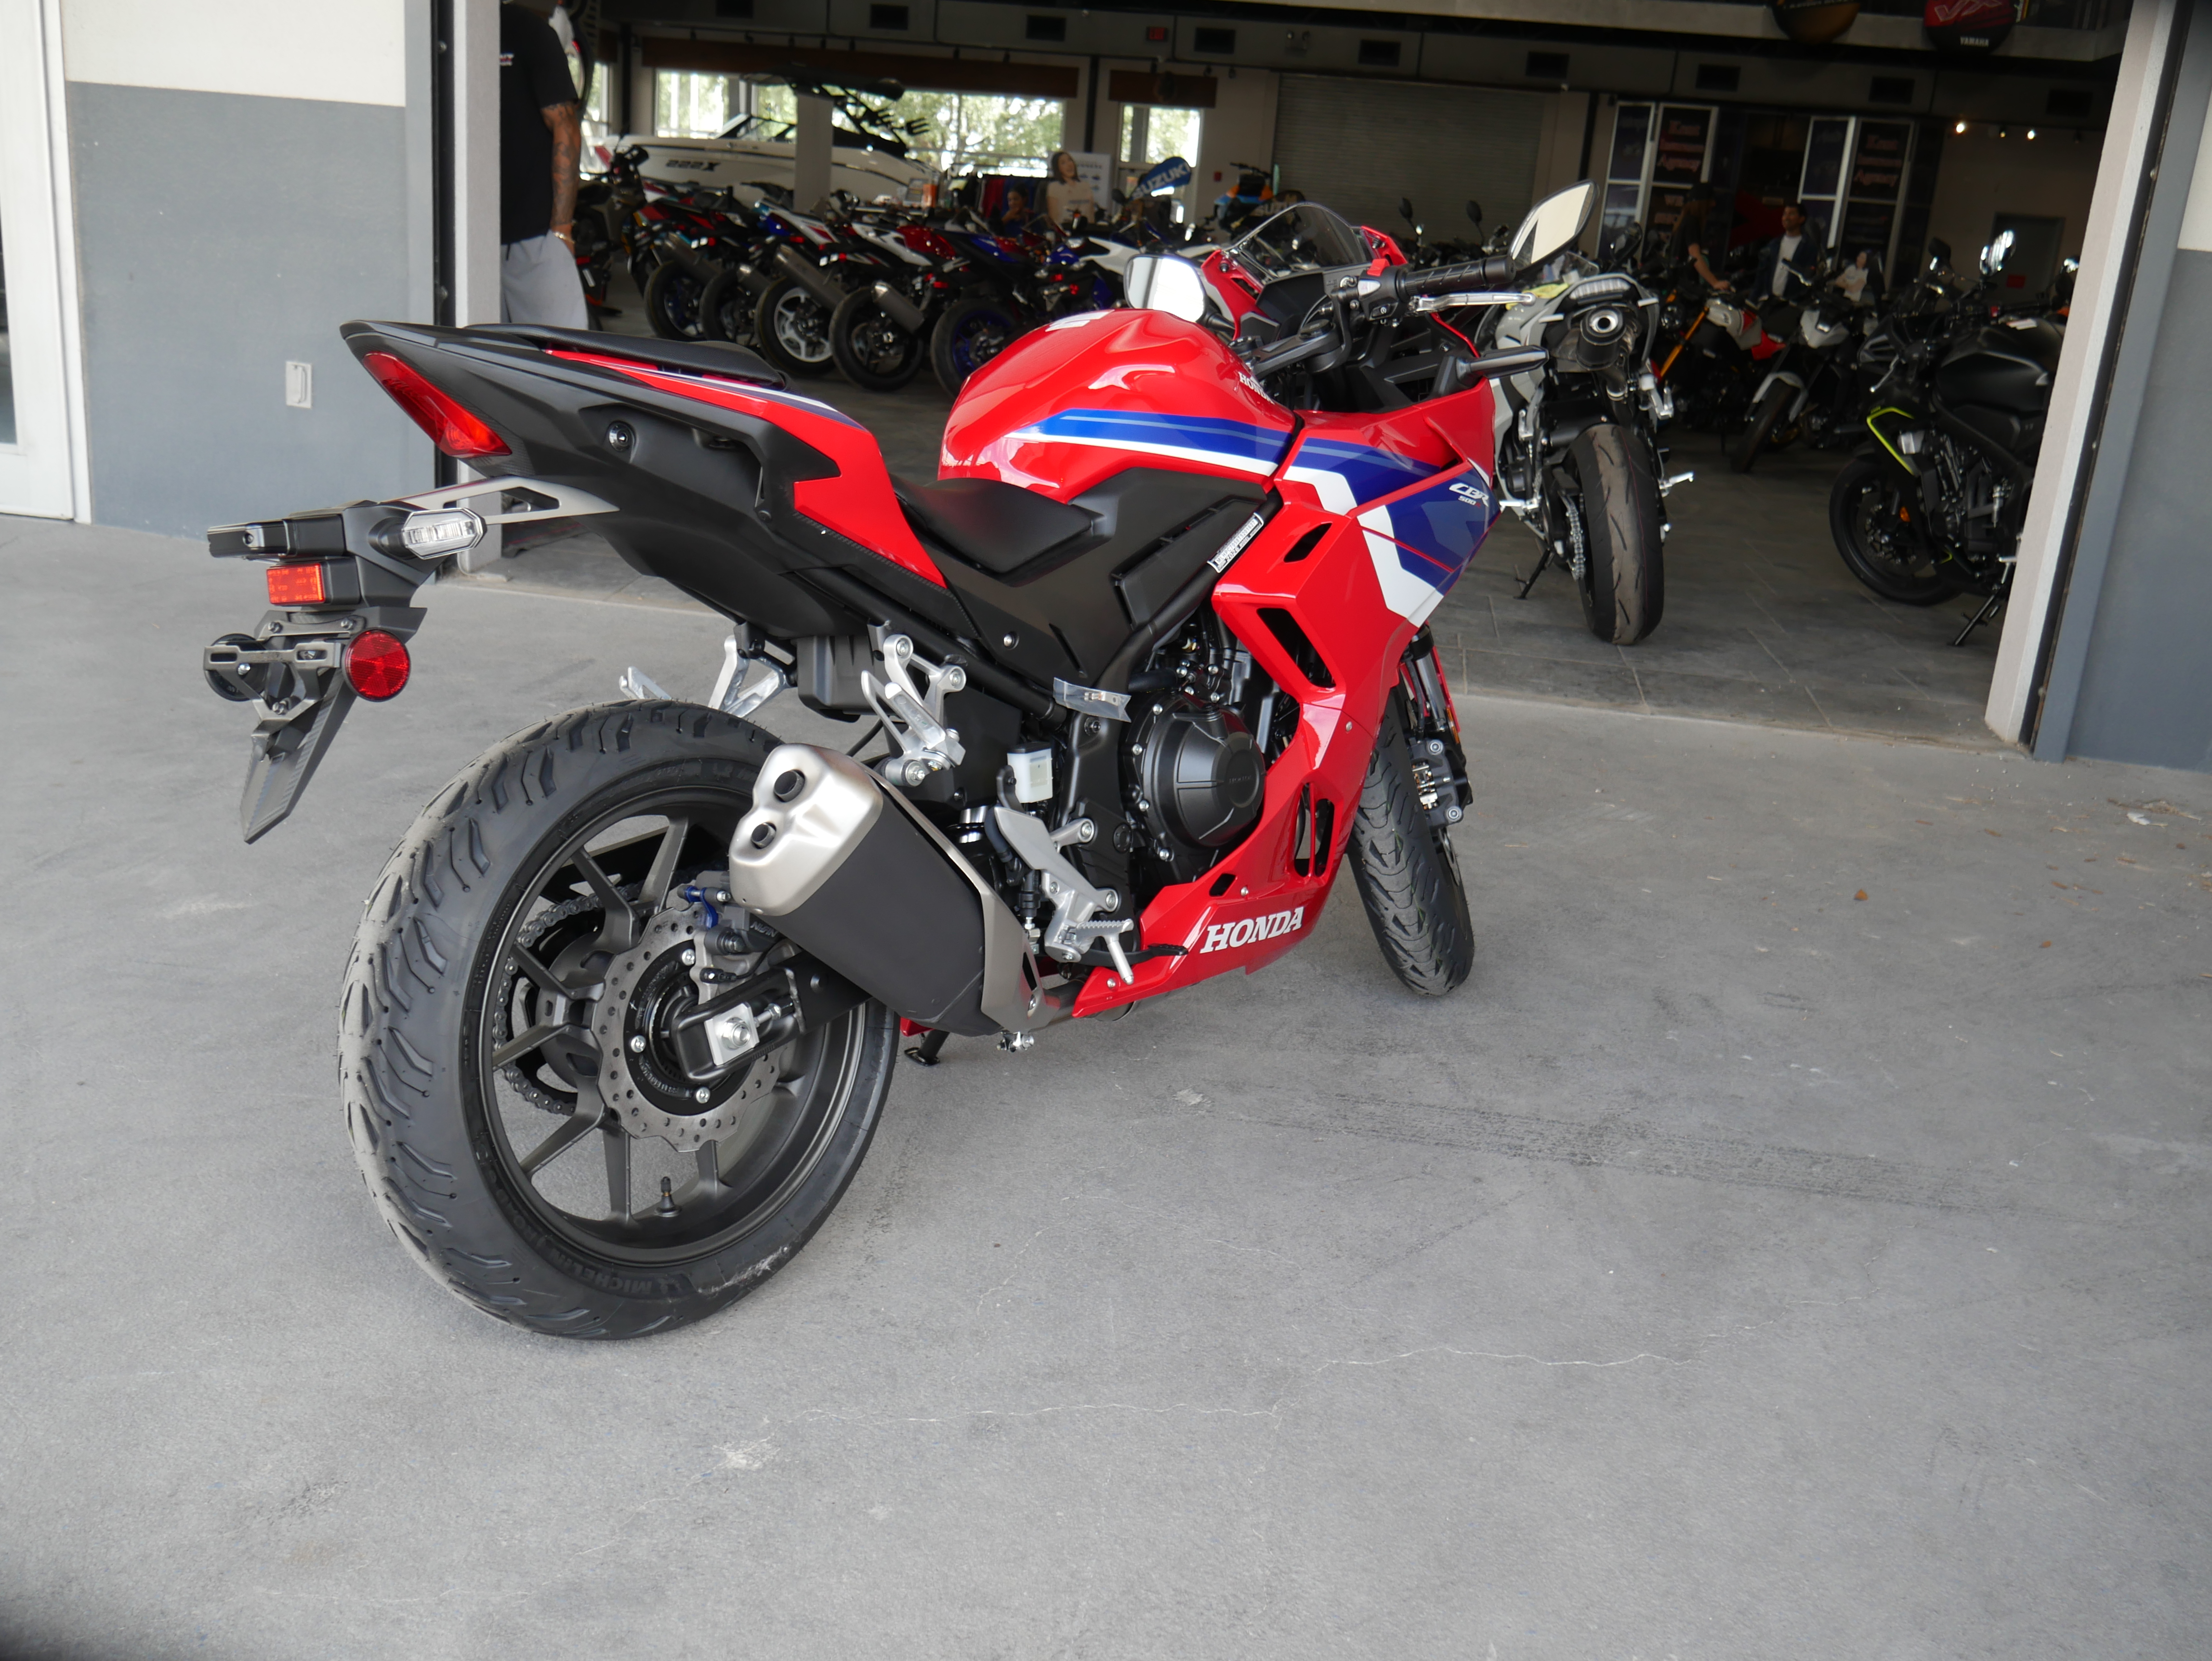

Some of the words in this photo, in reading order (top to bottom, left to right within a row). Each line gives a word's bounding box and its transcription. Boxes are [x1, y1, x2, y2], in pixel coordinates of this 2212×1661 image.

[1960, 36, 1989, 47] YAMAHA
[1133, 163, 1191, 200] SUZUKI
[1238, 371, 1276, 404] HONDA
[1448, 483, 1489, 507] CBR
[1199, 906, 1304, 954] HONDA
[549, 1248, 653, 1294] MICHELIN
